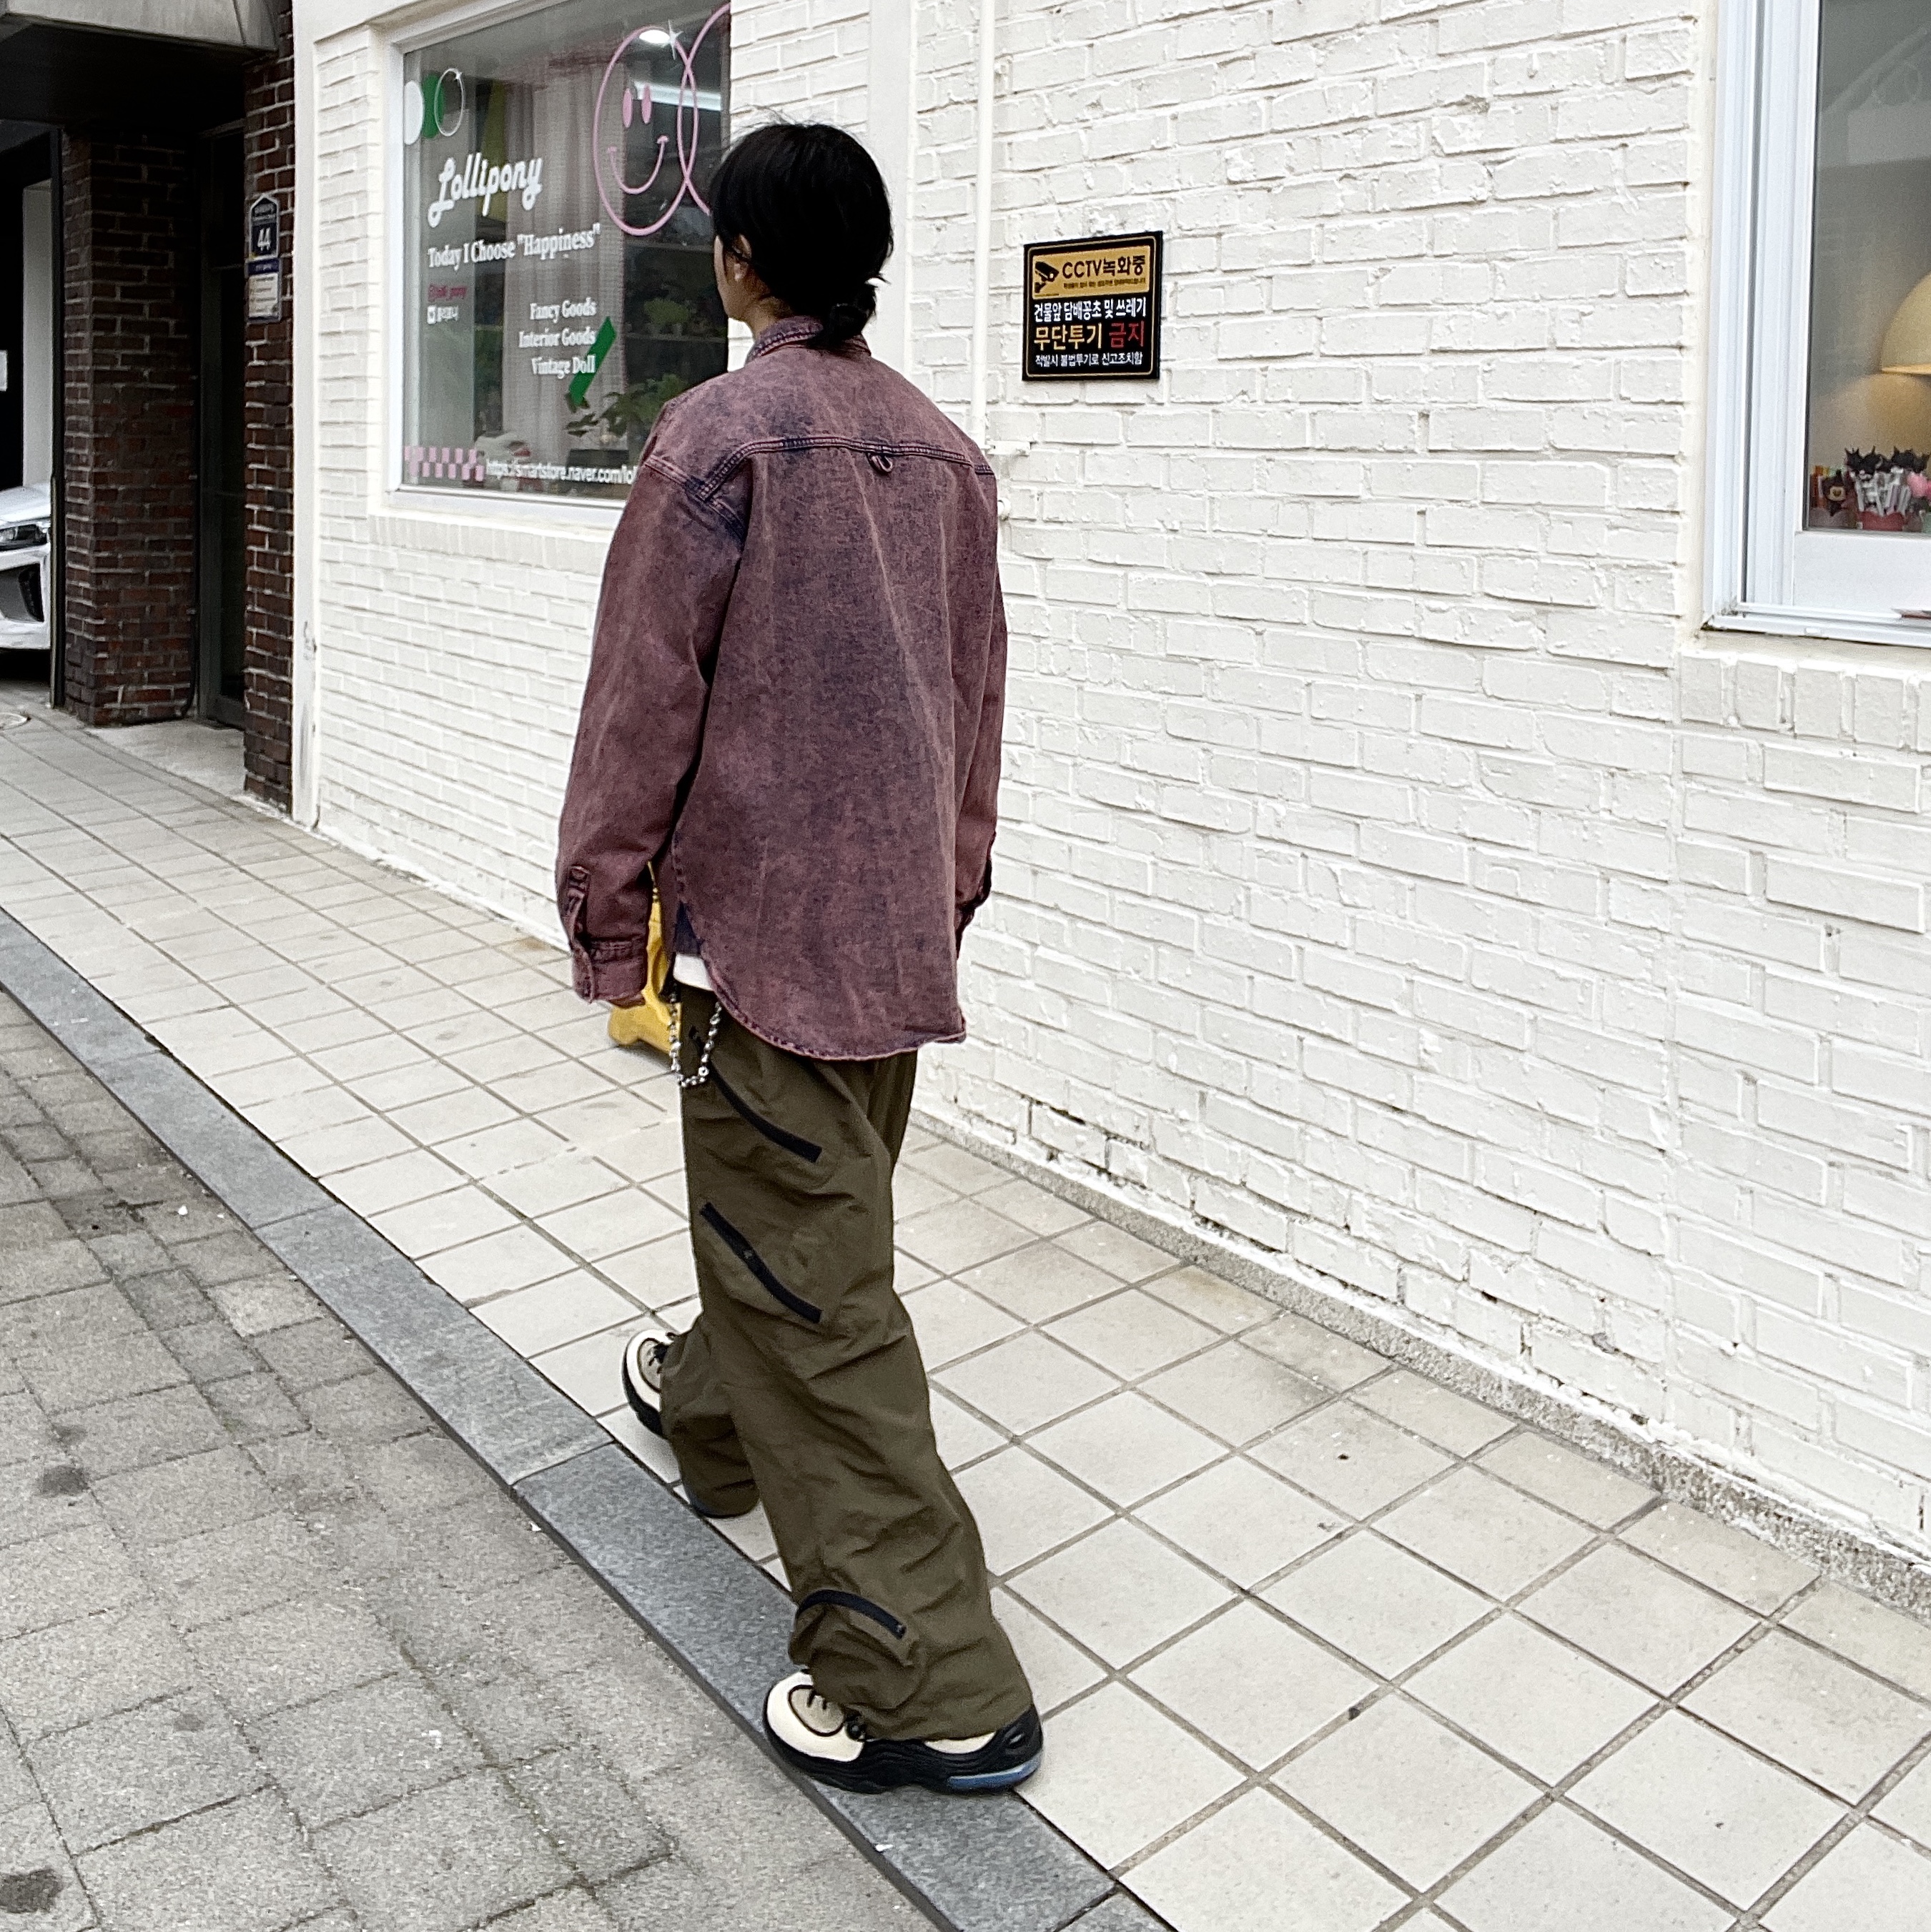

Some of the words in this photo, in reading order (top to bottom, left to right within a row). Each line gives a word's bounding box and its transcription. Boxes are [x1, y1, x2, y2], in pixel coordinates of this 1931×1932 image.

[428, 152, 543, 227] Lollipony
[257, 227, 272, 251] 44
[428, 245, 462, 271] Today
[463, 243, 470, 263] I
[471, 239, 516, 263] Choose
[517, 222, 601, 260] "Happiness"
[1062, 255, 1146, 279] CCTV녹화중
[530, 302, 560, 324] Fancy
[561, 297, 597, 318] Goods
[1034, 302, 1062, 322] 건물앞
[1064, 300, 1102, 321] 담배꽁초
[1104, 298, 1113, 319] 및
[1116, 297, 1146, 317] 쓰레기
[518, 327, 560, 348] Interior
[561, 326, 597, 347] Goods
[1034, 322, 1102, 351] 무단투기
[1109, 320, 1145, 348] 금지
[531, 357, 571, 380] Vintage
[572, 354, 596, 374] Doll
[1035, 354, 1058, 367] 적발시
